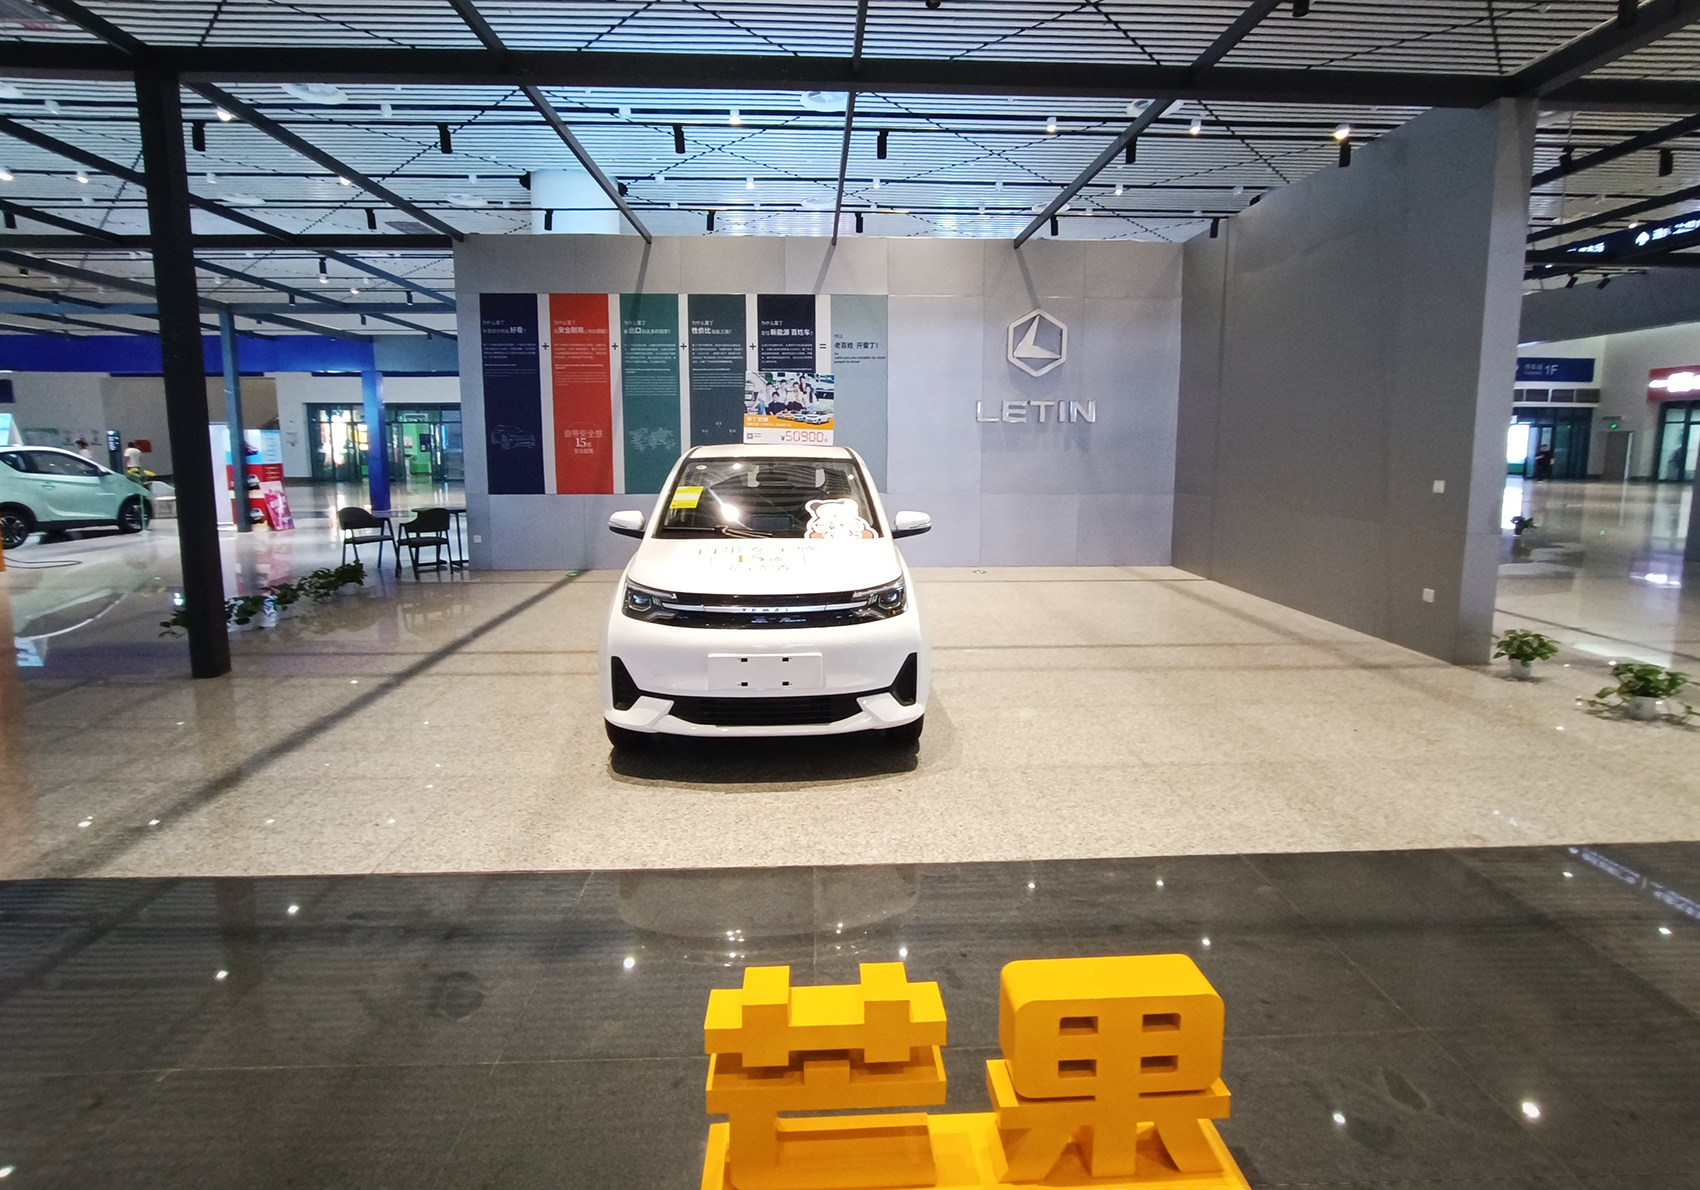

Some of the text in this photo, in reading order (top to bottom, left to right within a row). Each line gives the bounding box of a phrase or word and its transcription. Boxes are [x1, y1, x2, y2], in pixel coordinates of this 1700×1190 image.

[834, 341, 854, 349] 老百姓
[1544, 364, 1559, 376] 1F
[975, 400, 1096, 423] LETIN
